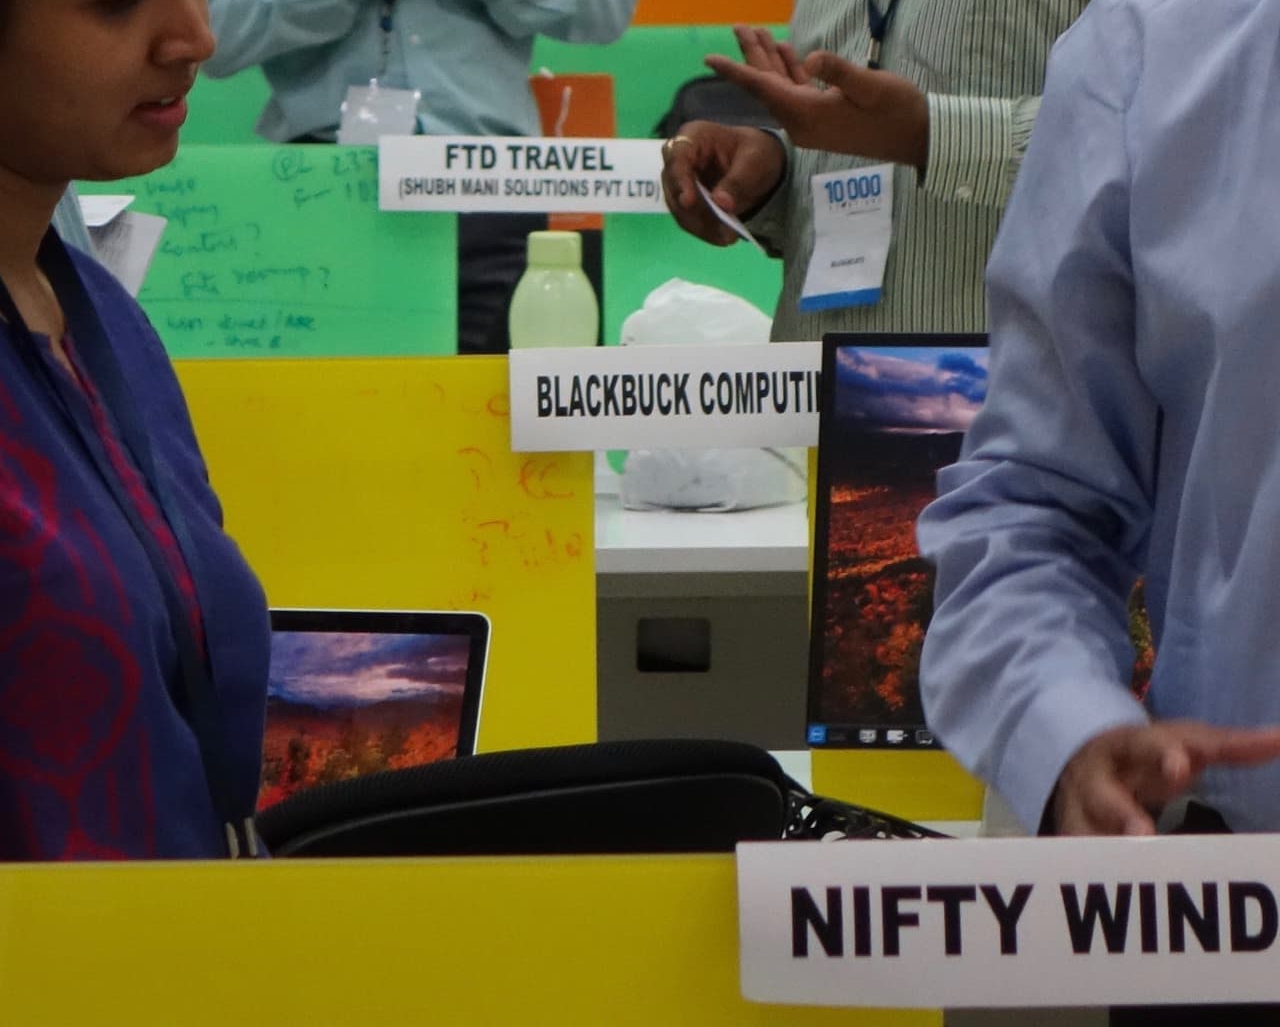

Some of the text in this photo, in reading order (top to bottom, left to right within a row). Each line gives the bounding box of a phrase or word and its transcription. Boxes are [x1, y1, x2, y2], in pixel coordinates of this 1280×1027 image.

[446, 144, 614, 171] FTD TRAVEL
[398, 178, 455, 200] (SHUBH
[461, 178, 499, 197] MANI
[505, 178, 588, 197] SOLUTIONS
[594, 180, 622, 198] PVT
[627, 180, 660, 201] LTD)
[537, 372, 691, 417] BLACKBUCK
[790, 883, 1034, 958] NIFTY
